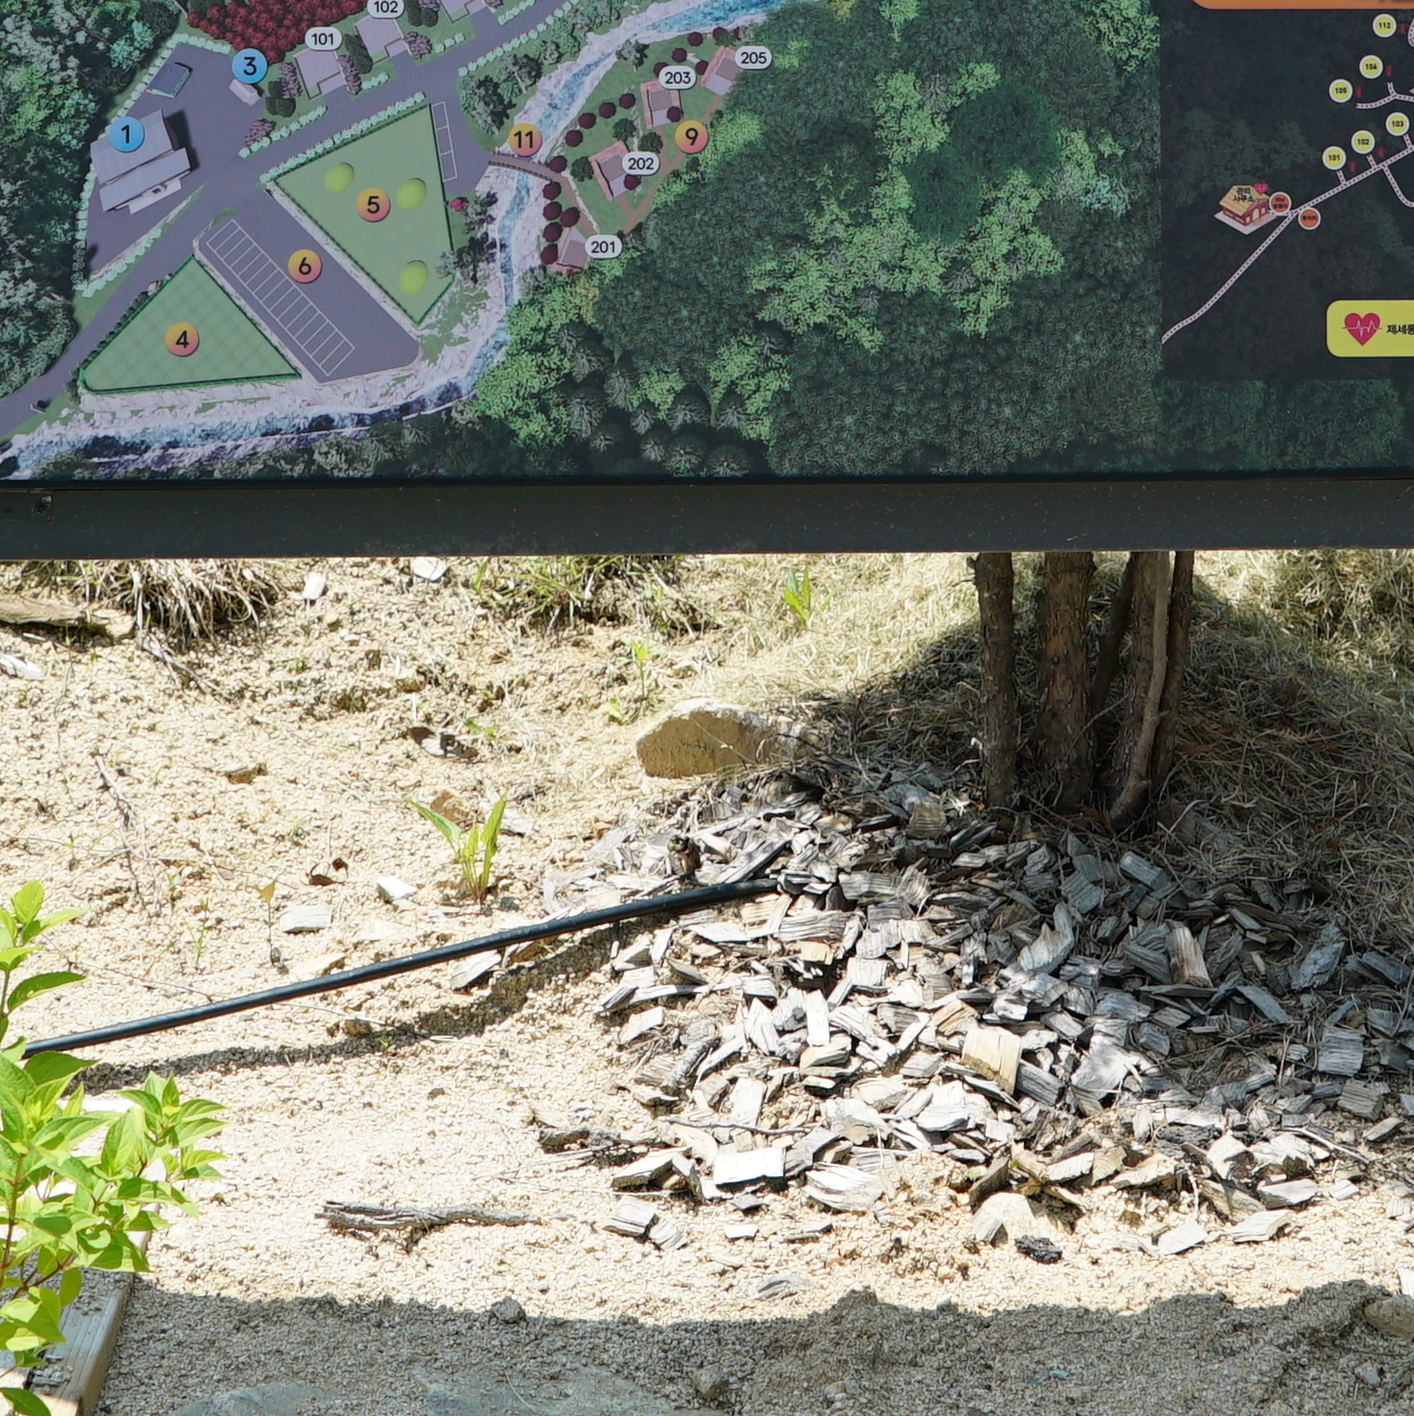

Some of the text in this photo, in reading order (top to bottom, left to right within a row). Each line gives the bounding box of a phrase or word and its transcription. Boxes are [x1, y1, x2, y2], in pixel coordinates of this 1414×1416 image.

[373, 0, 398, 14] 102
[1378, 21, 1391, 29] 112
[312, 32, 334, 46] 101
[740, 51, 767, 65] 205
[243, 56, 257, 76] 3
[665, 71, 691, 85] 203
[121, 124, 130, 144] 1
[513, 130, 534, 149] 11
[685, 127, 699, 146] 9
[628, 157, 654, 170] 202
[1328, 154, 1341, 162] 101
[367, 195, 380, 215] 5
[591, 240, 615, 254] 201
[298, 257, 312, 276] 6
[175, 330, 190, 349] 4
